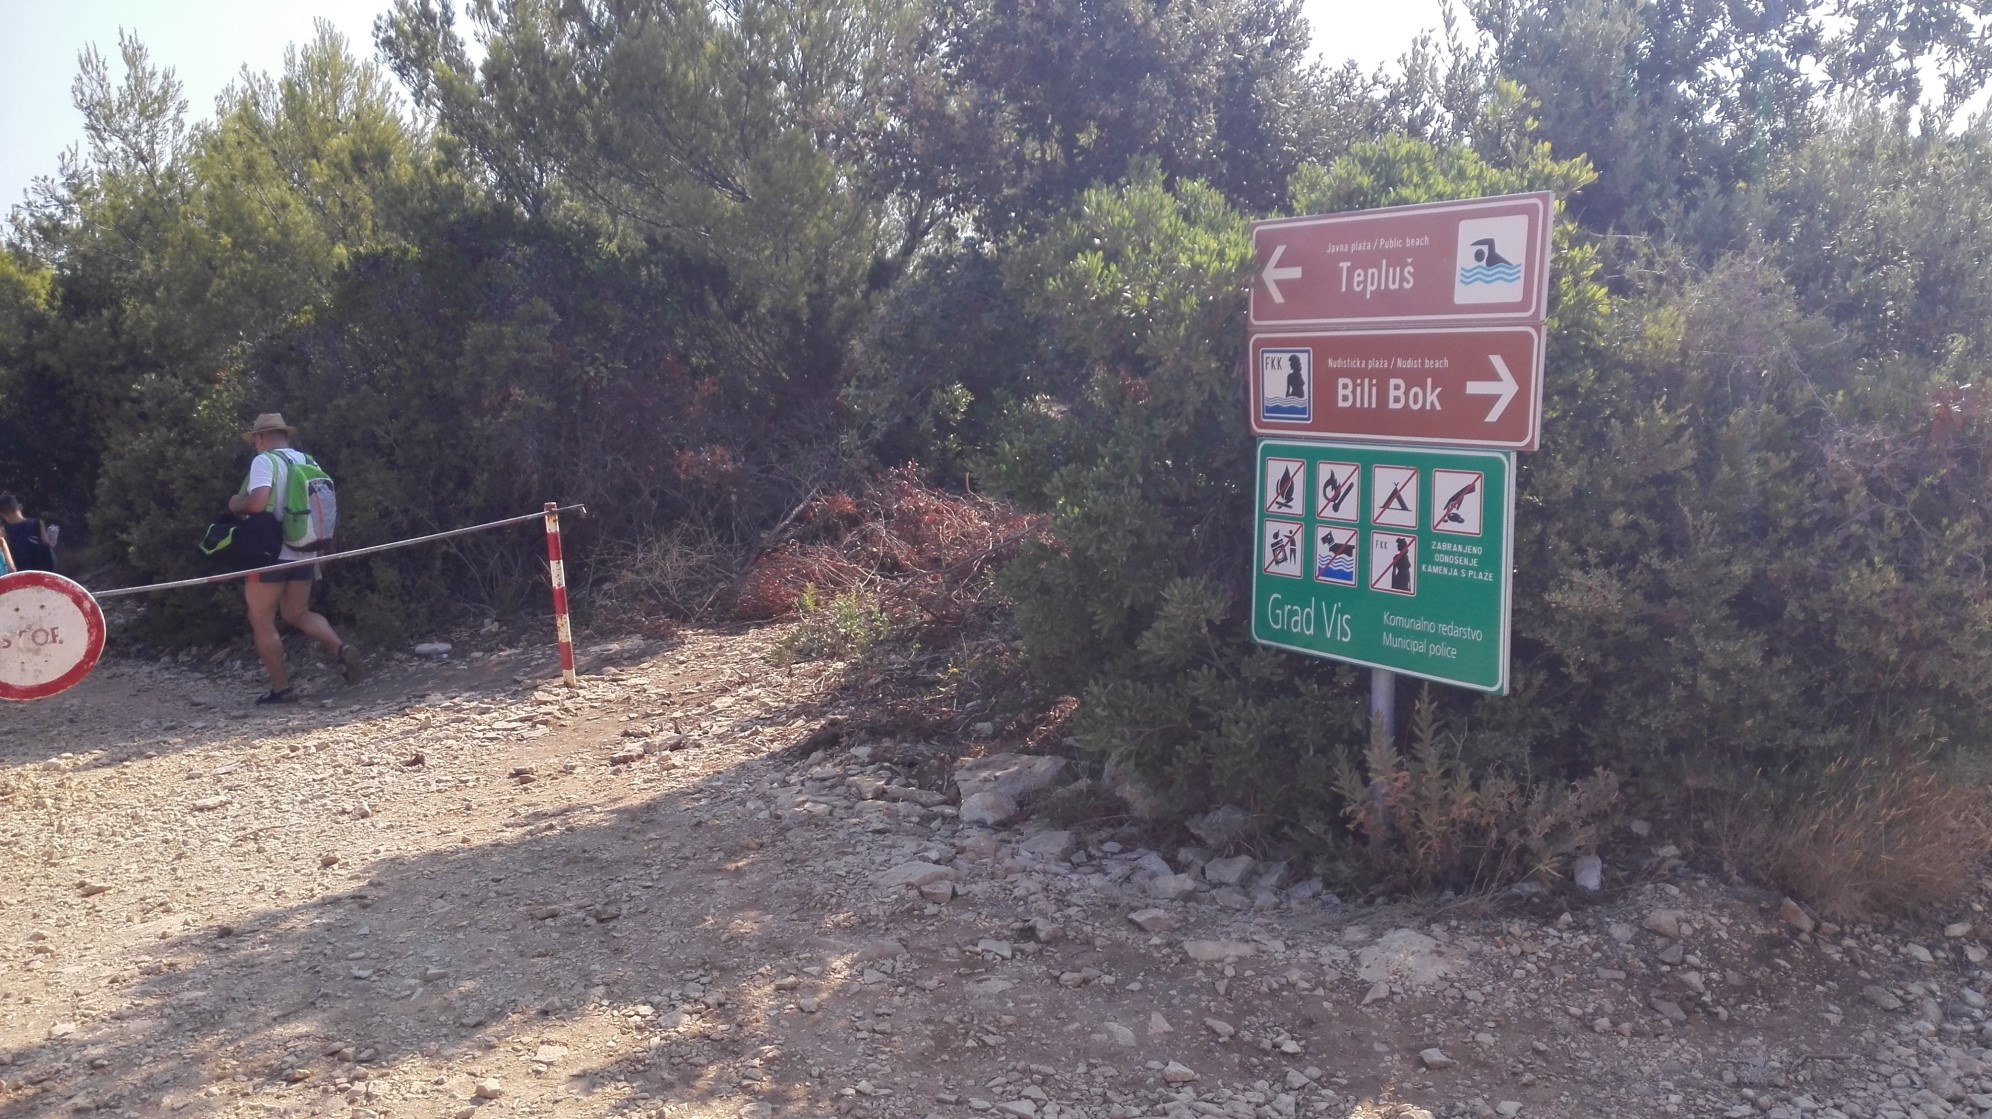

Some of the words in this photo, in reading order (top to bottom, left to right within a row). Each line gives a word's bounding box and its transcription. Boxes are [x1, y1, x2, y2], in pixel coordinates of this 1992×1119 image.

[1326, 243, 1349, 254] Javna
[1373, 238, 1379, 251] /
[1380, 237, 1403, 249] Public
[1405, 235, 1430, 247] beach
[1339, 257, 1415, 300] Tepluš
[1265, 356, 1283, 370] FKK
[1390, 356, 1395, 369] /
[1397, 357, 1422, 369] Nudist
[1424, 357, 1449, 369] beach
[1337, 377, 1377, 409] Bili
[1388, 377, 1443, 411] Bok
[1375, 540, 1388, 550] FKK
[1431, 541, 1483, 555] ZABRANJENO
[1421, 564, 1458, 577] KAMENJA
[1460, 569, 1466, 578] S
[1268, 593, 1315, 636] Grad
[1322, 601, 1351, 643] Vis
[1383, 610, 1436, 633] Komunalno
[1438, 620, 1483, 642] redarstvo
[1382, 631, 1427, 655] Municipal
[1429, 641, 1457, 659] police
